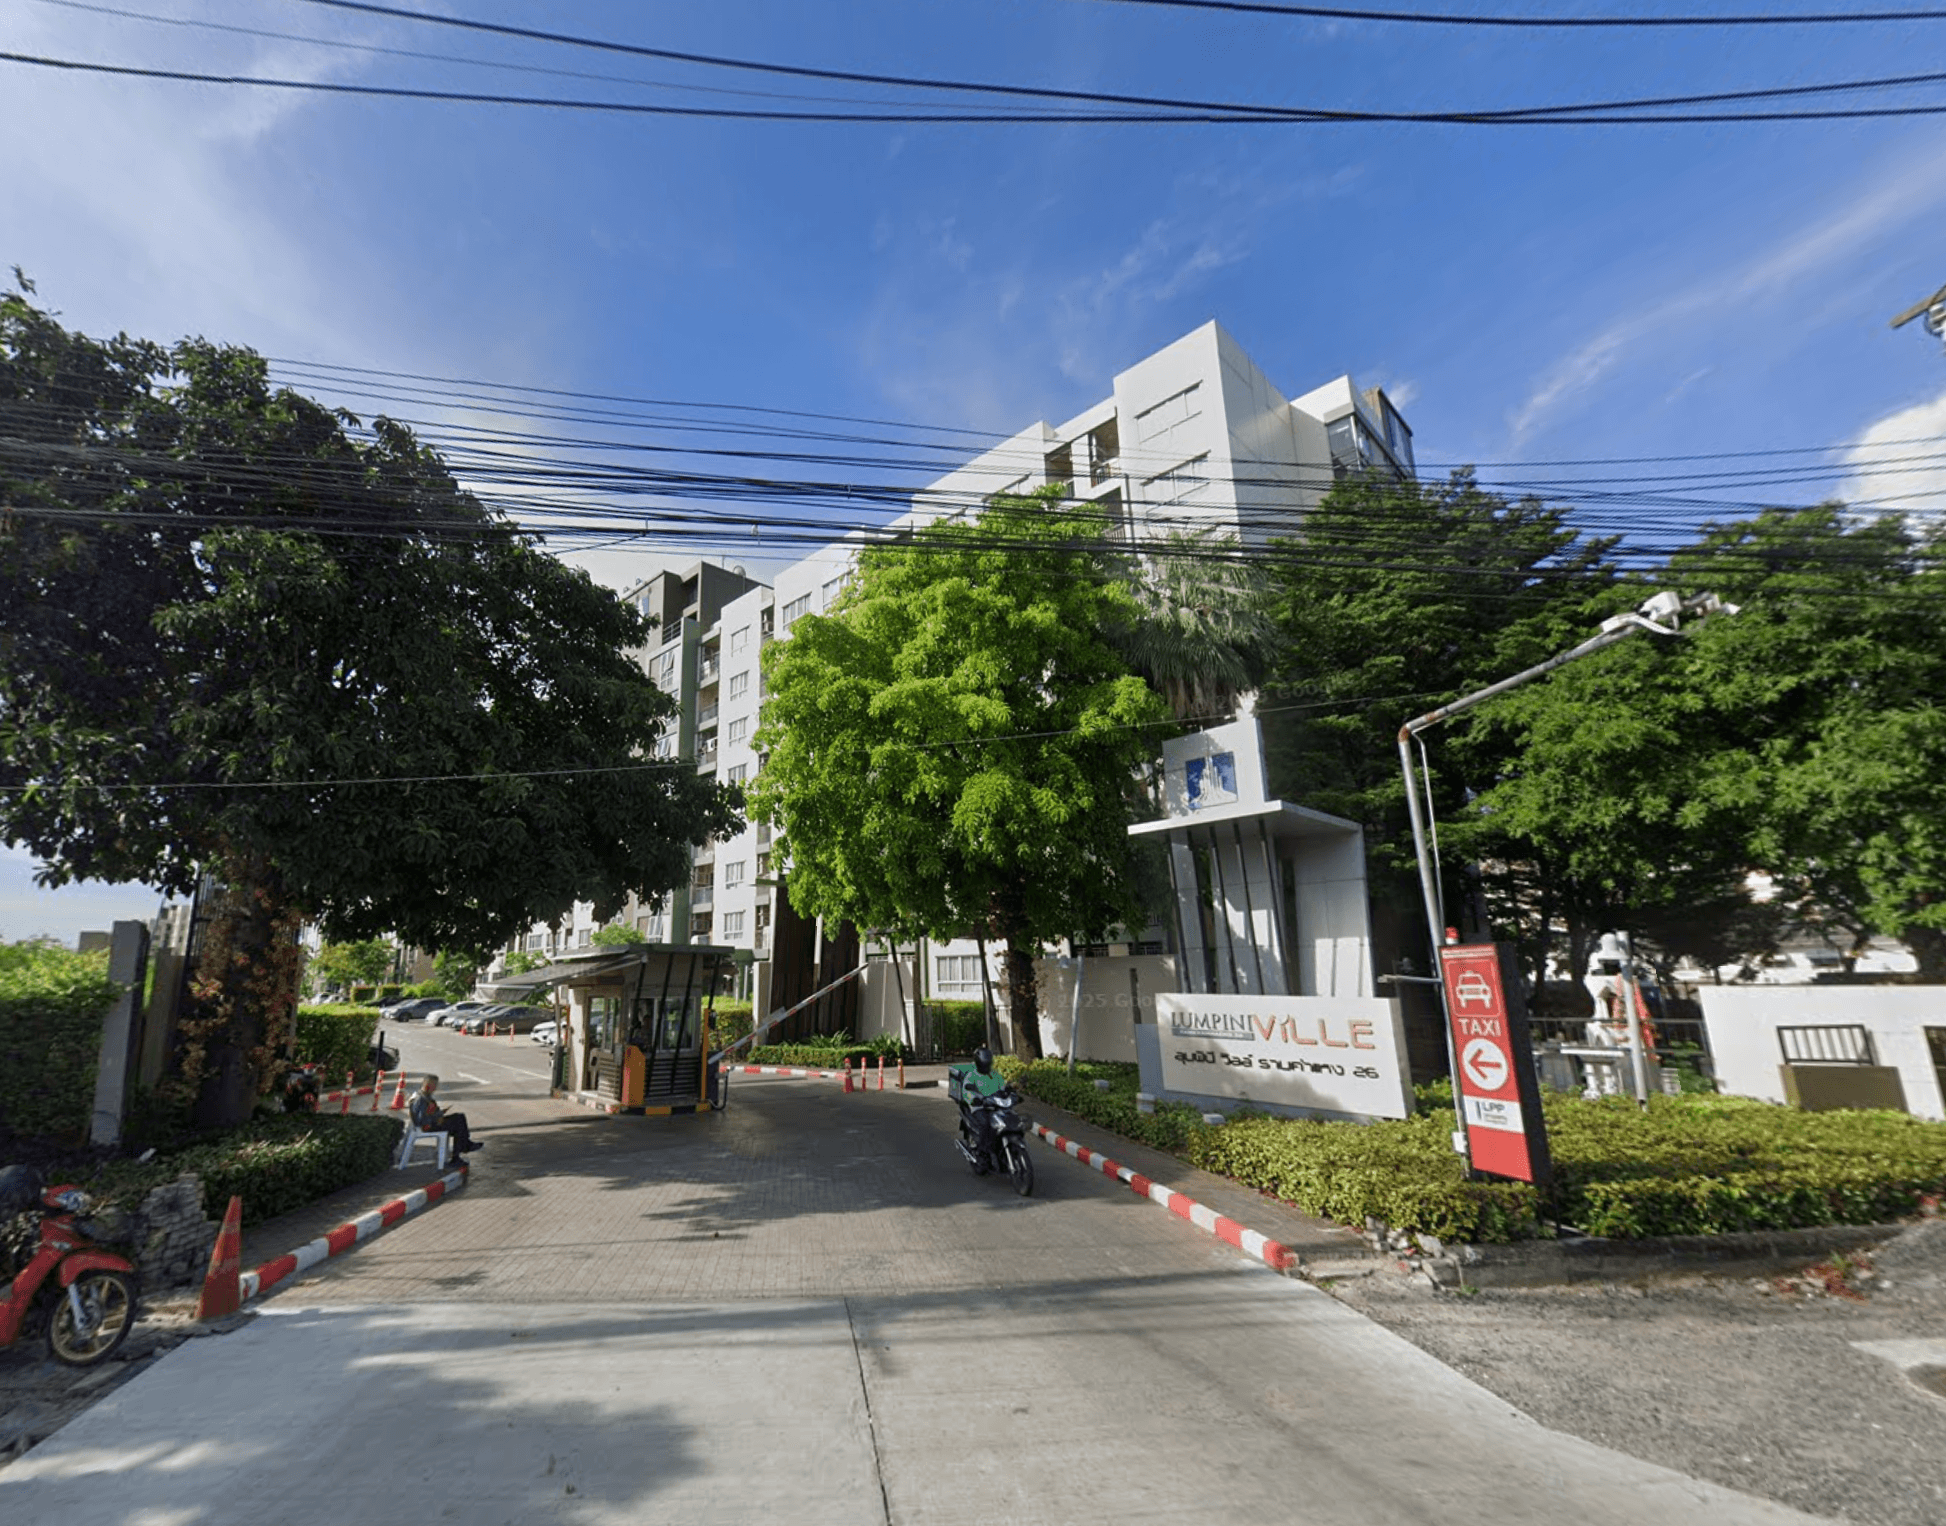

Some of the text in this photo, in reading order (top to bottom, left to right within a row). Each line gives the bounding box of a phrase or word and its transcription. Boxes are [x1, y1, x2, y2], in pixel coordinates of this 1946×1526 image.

[1171, 1011, 1254, 1032] LUMPINI
[1458, 1018, 1502, 1037] TAXI
[1258, 1058, 1345, 1076] รามคำแหง
[1352, 1065, 1380, 1079] 26
